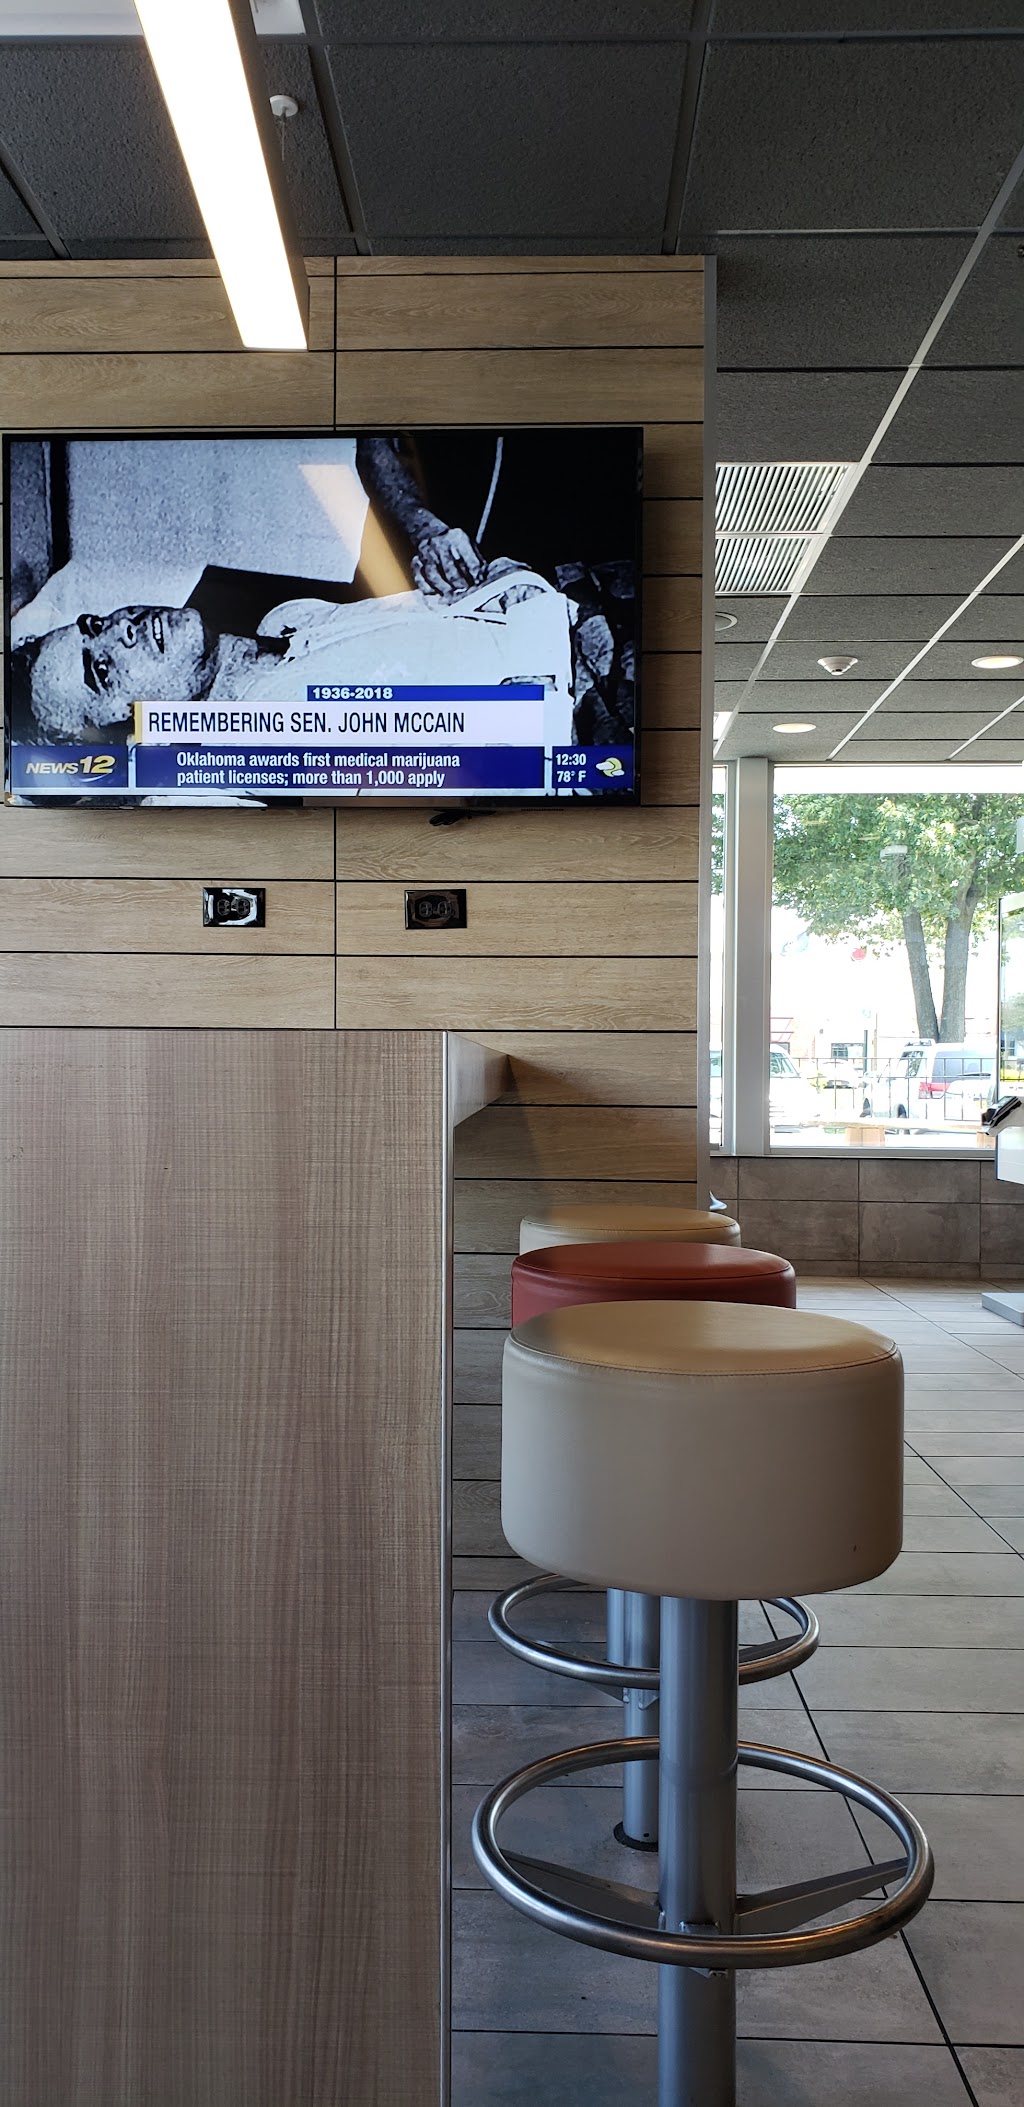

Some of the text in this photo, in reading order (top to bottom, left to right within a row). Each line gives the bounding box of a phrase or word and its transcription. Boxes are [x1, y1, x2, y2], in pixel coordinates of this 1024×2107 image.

[312, 687, 393, 700] 1936-2018
[148, 711, 465, 733] REMEMBERING SEN. JOHN MCCAIN
[176, 752, 460, 770] Oklahoma awards first medical marijuana
[555, 753, 587, 766] 12:30
[177, 769, 445, 788] patient licenses; more than 1,000 apply
[578, 770, 587, 783] F
